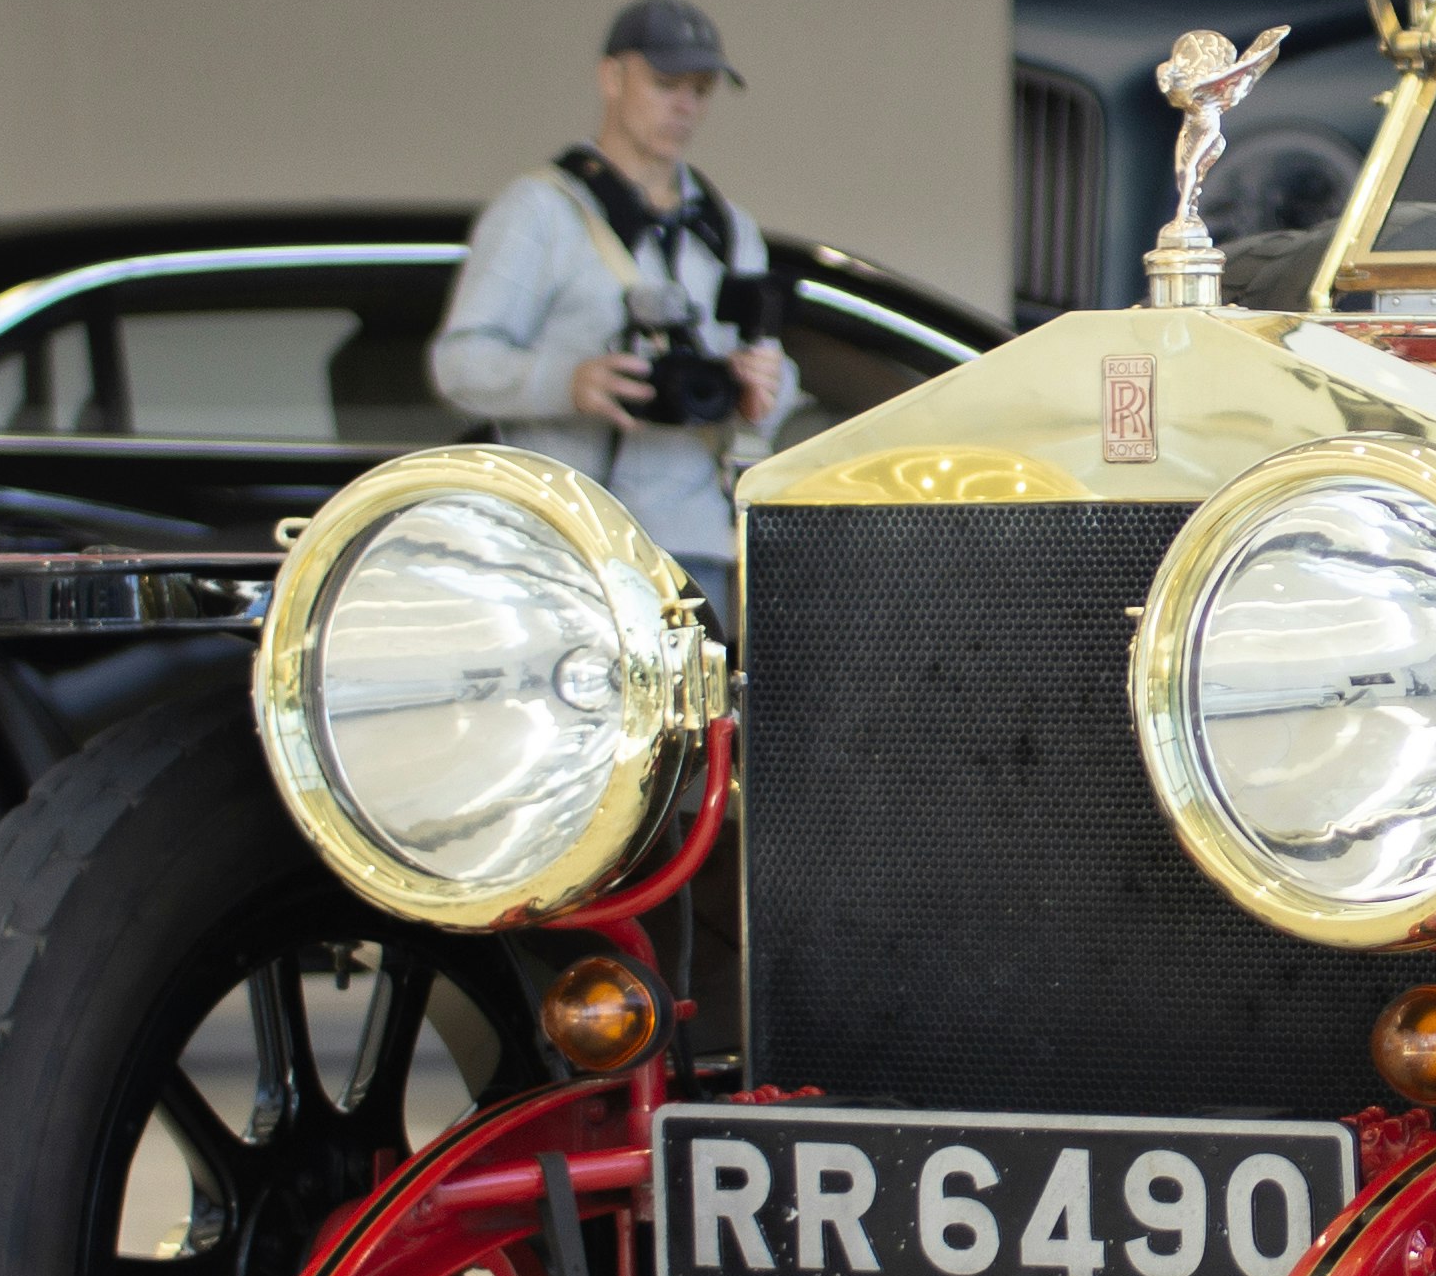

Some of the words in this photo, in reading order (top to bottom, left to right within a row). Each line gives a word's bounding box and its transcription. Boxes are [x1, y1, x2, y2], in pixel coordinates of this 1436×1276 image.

[1108, 361, 1150, 375] ROLLS
[1109, 443, 1152, 457] ROYCE
[690, 1137, 881, 1273] RR
